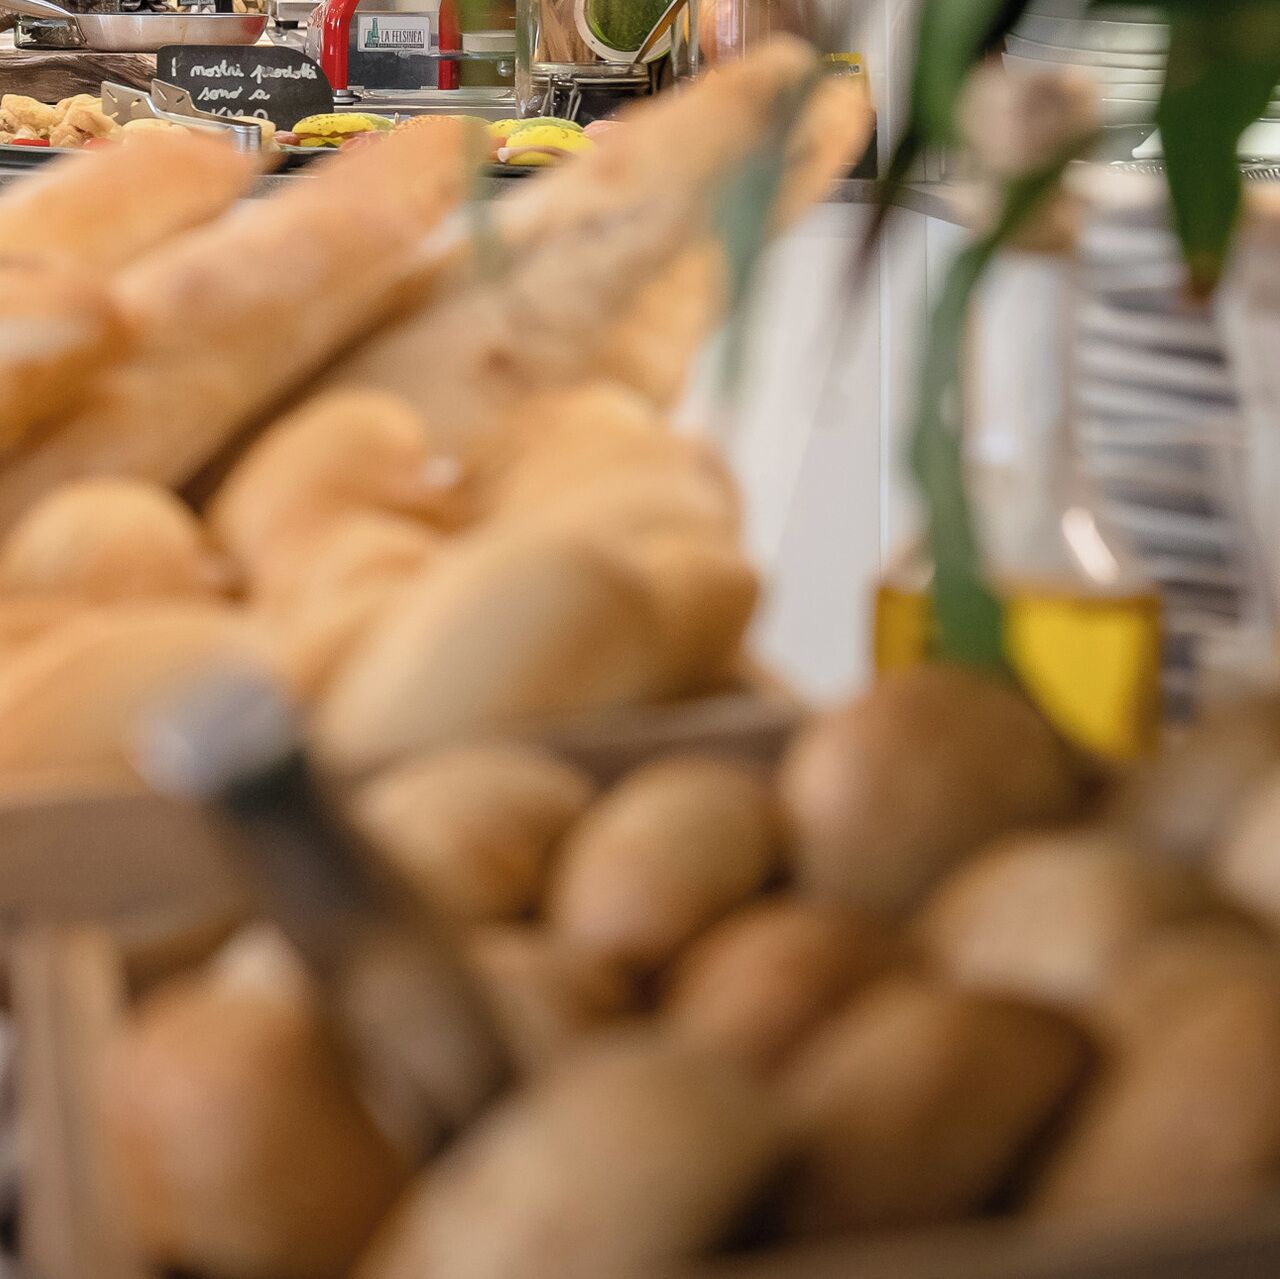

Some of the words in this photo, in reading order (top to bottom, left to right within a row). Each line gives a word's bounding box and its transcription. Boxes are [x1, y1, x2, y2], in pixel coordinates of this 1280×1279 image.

[381, 30, 390, 43] LA
[171, 57, 177, 77] I
[190, 60, 244, 78] nostri
[250, 62, 318, 84] prodotti
[197, 86, 244, 100] sono
[248, 88, 271, 100] a
